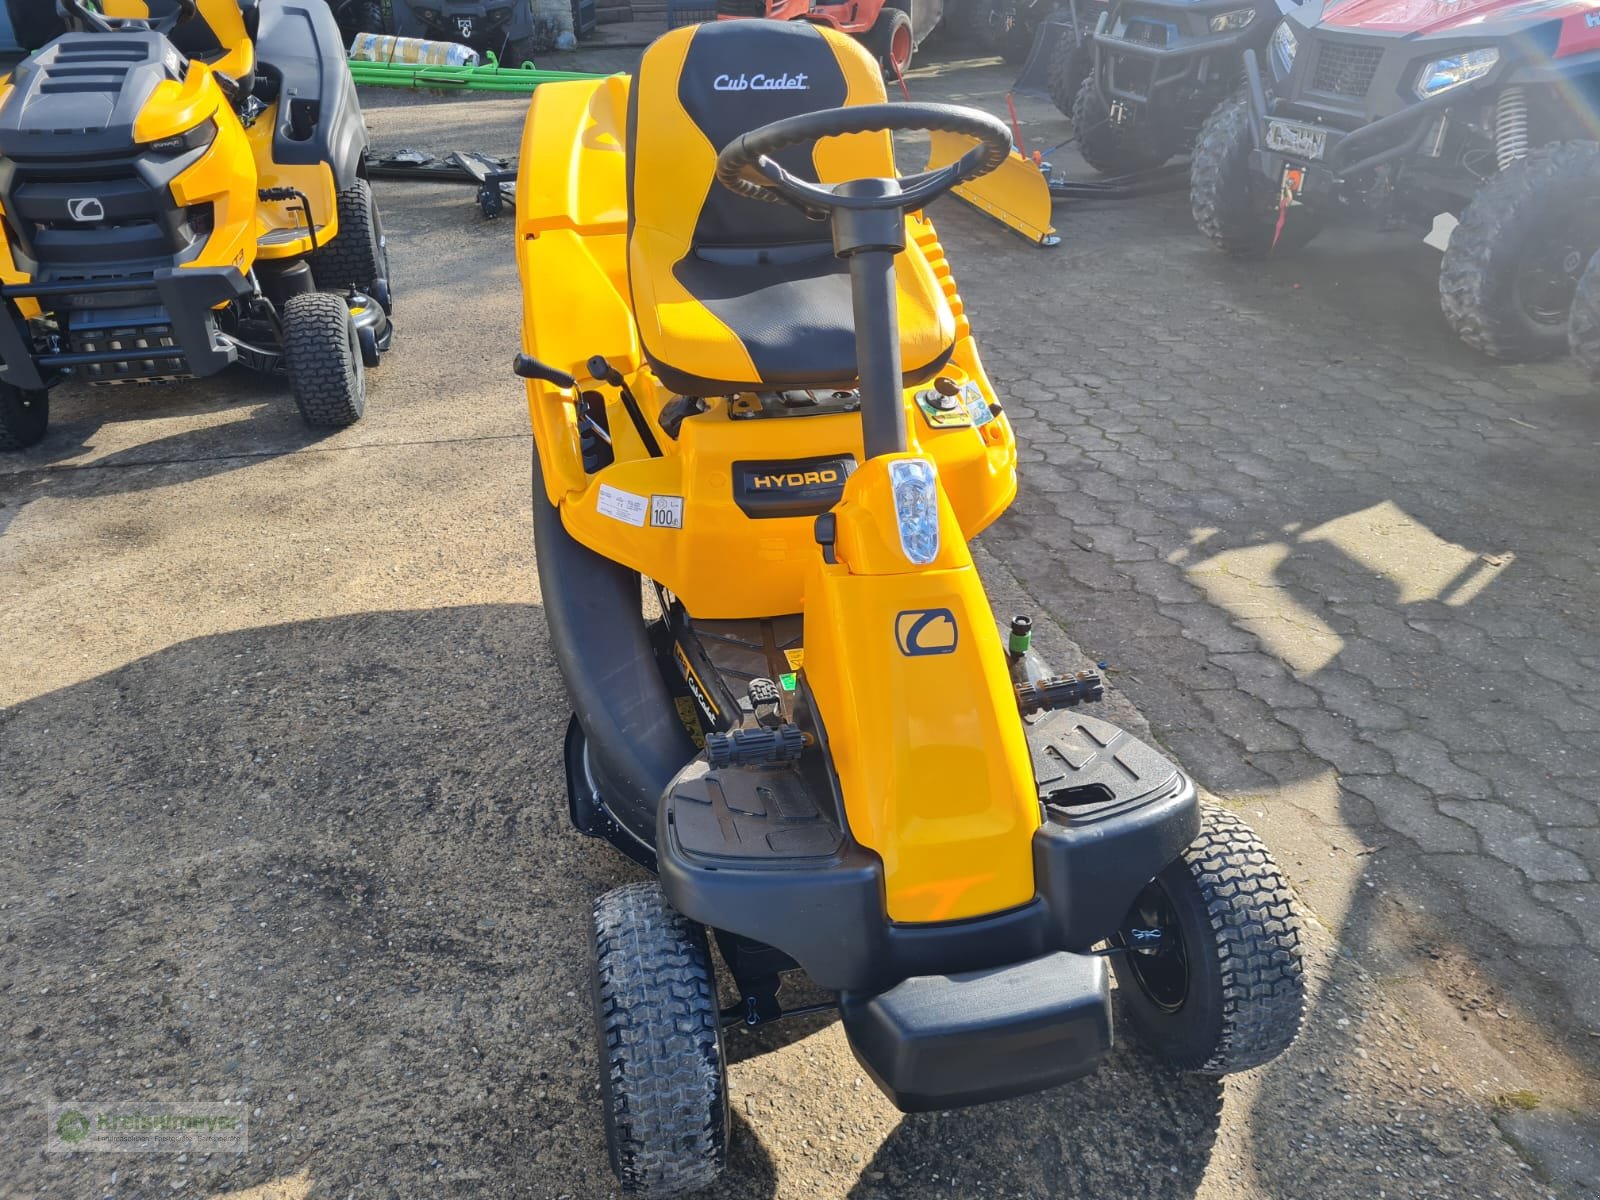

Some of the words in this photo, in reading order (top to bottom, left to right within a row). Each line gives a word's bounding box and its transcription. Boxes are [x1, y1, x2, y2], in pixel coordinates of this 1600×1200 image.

[713, 73, 748, 91] Cub
[749, 72, 809, 90] Cadet
[753, 469, 838, 489] HYDRO
[654, 509, 673, 525] 100
